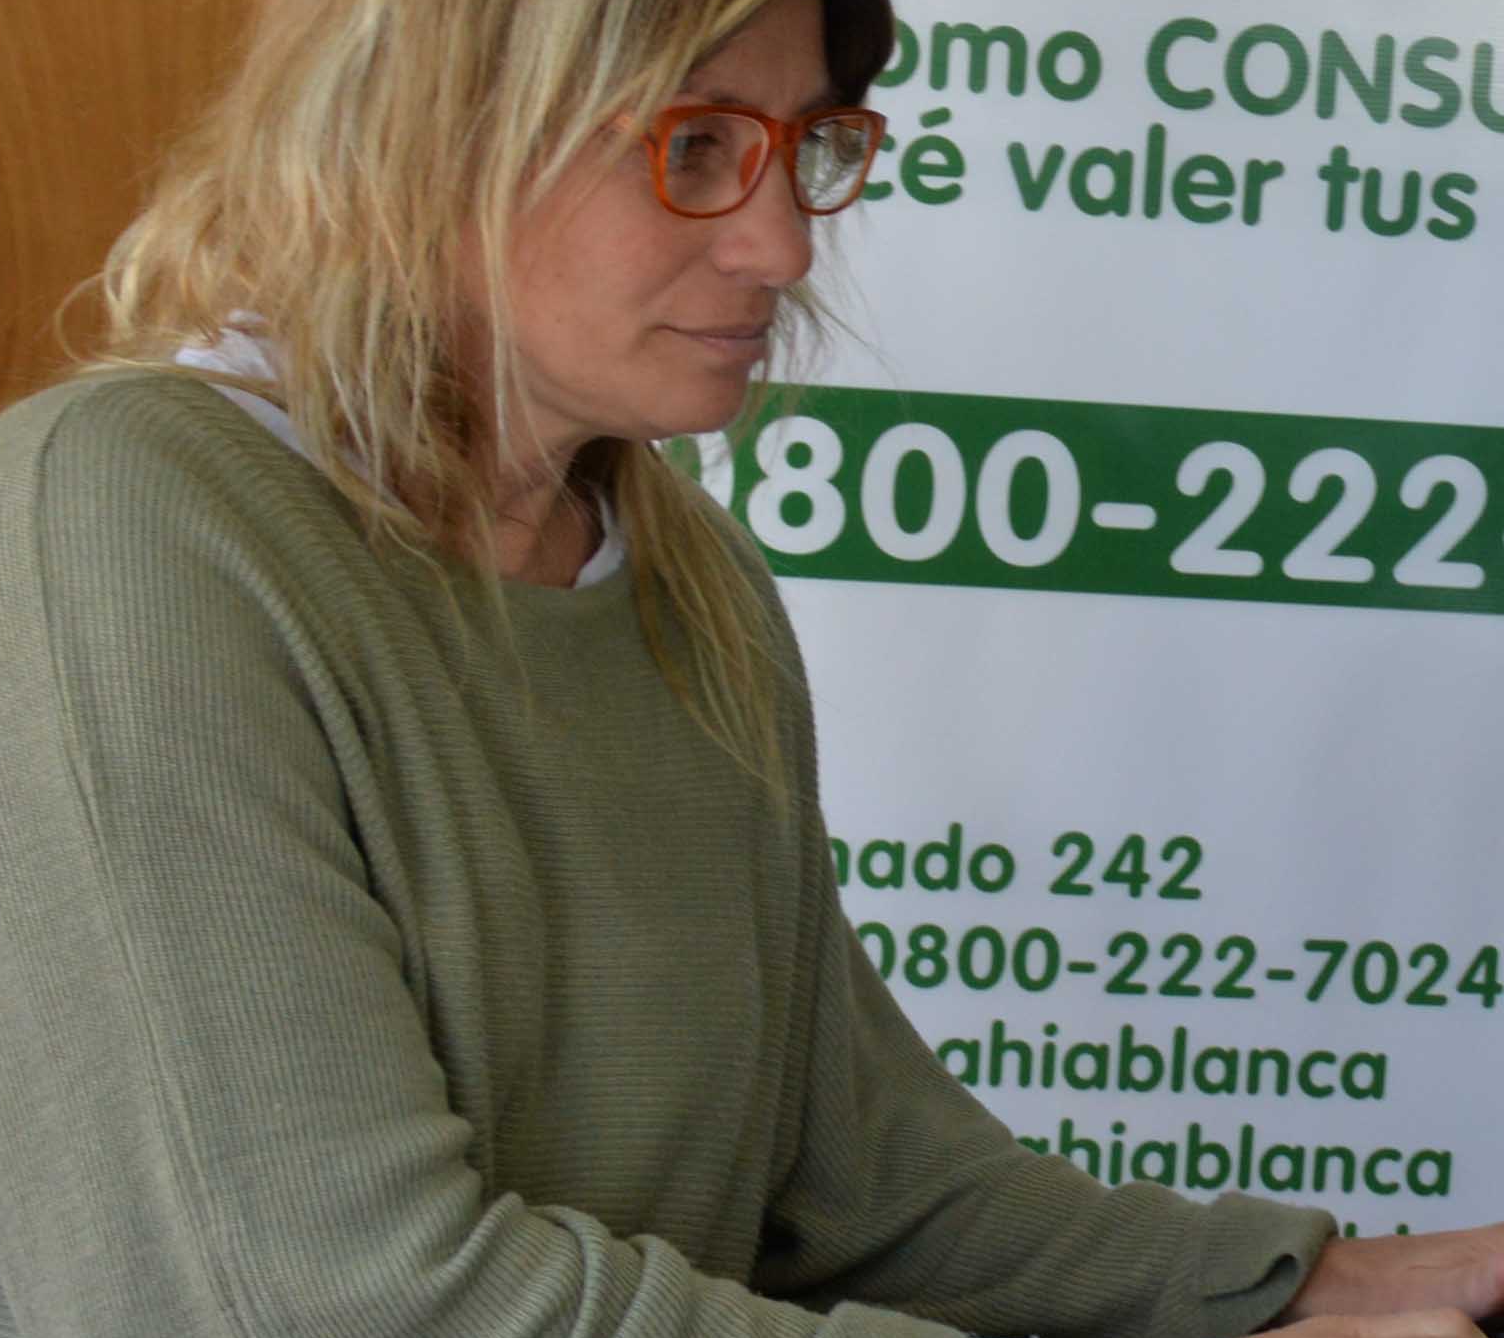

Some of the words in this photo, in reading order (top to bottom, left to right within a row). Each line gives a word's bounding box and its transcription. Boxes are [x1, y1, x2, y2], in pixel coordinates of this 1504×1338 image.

[871, 17, 1102, 101] omo
[1008, 124, 1284, 229] valer
[1317, 148, 1477, 244] tus
[1048, 833, 1204, 901] 242
[937, 1019, 1389, 1101] ahiablanca
